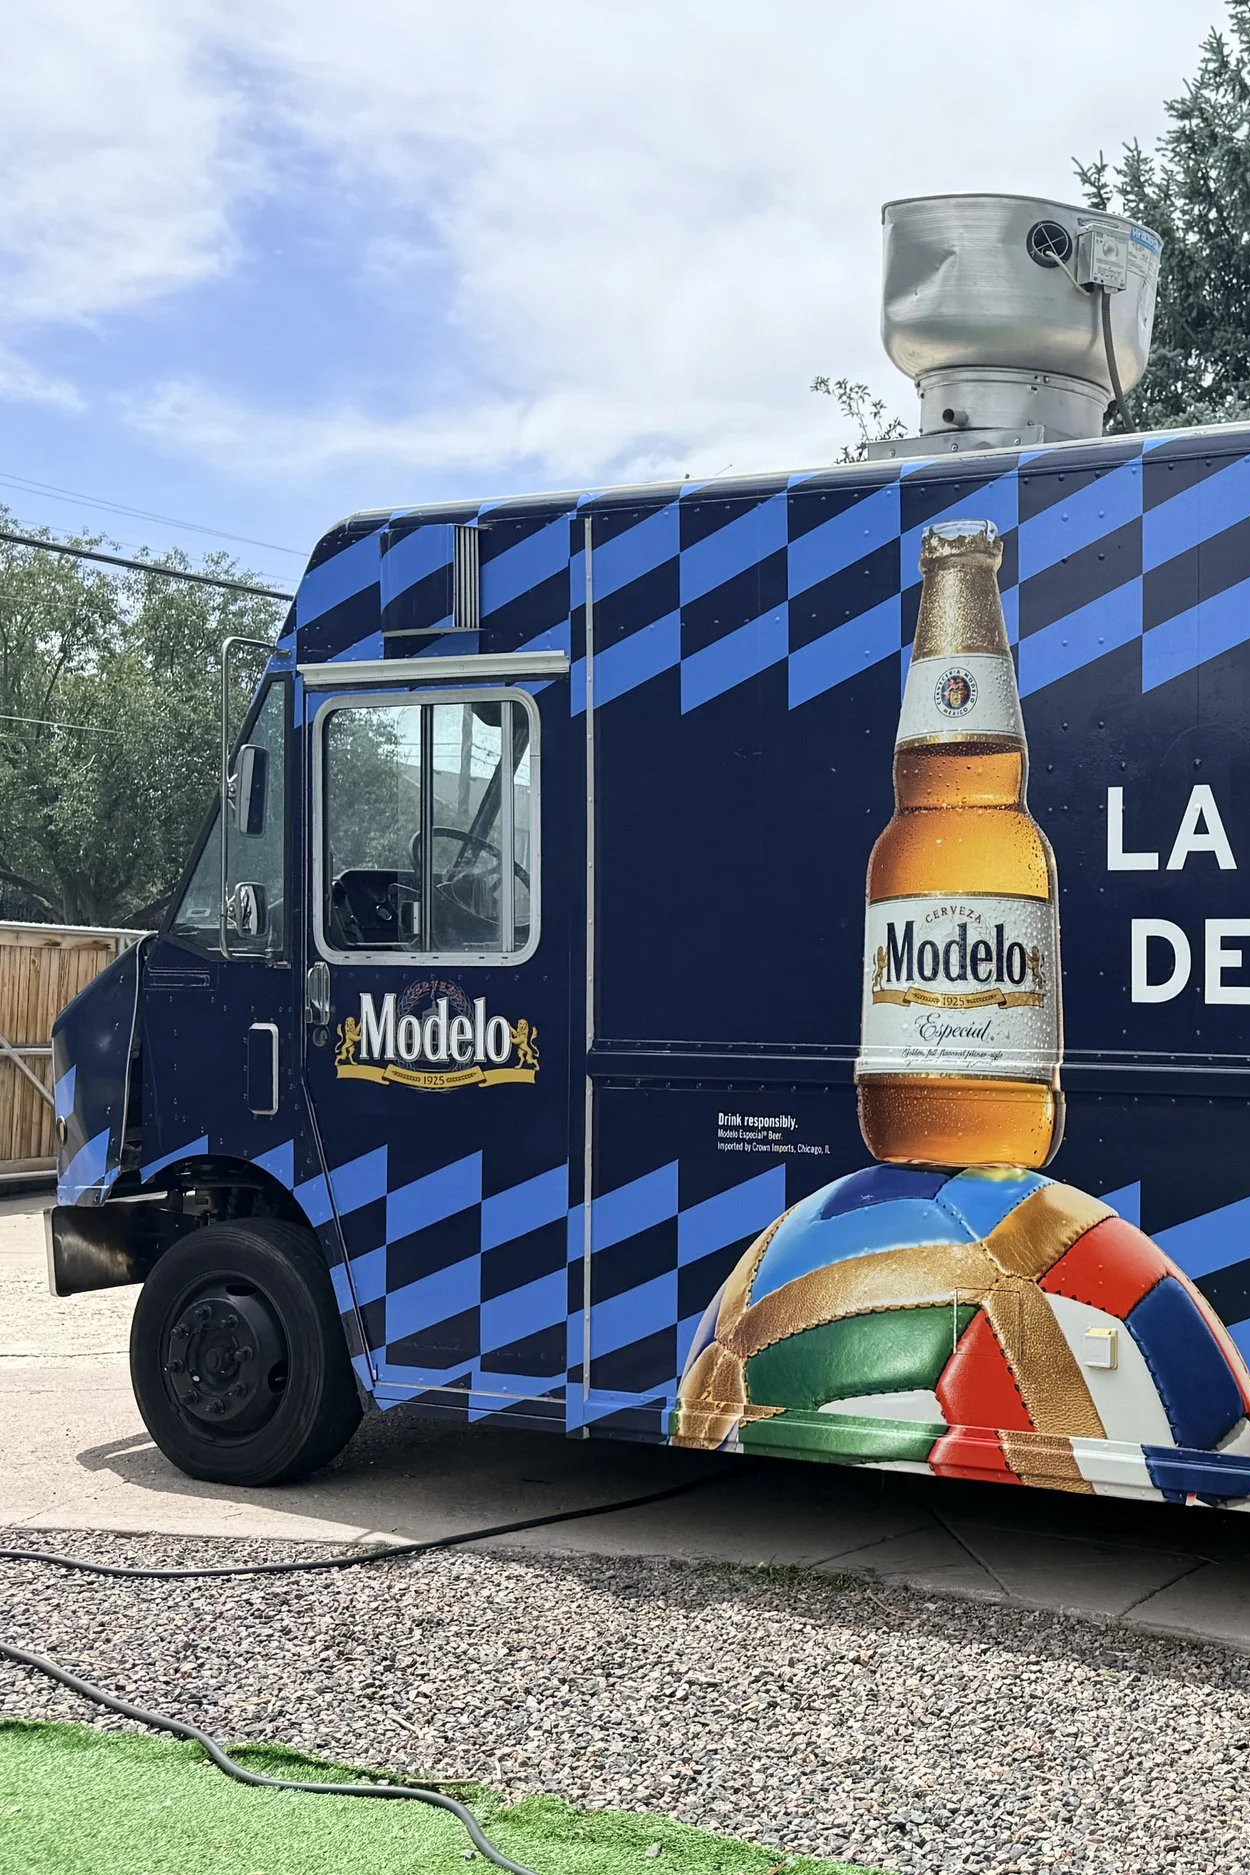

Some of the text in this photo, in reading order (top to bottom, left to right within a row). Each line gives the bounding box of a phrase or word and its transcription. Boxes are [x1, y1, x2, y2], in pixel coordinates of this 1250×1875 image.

[1106, 785, 1238, 871] LA
[925, 906, 981, 924] CERVEZA
[886, 920, 1027, 985] Modelo
[941, 996, 965, 1006] 1925
[359, 992, 512, 1063] Modelo
[423, 1075, 445, 1086] 1925
[718, 1112, 798, 1130] Drink responsibly.
[717, 1129, 738, 1139] Modelo
[717, 1141, 743, 1151] Imported
[744, 1142, 752, 1152] by
[752, 1142, 771, 1152] Crown
[797, 1144, 824, 1155] Chicago,
